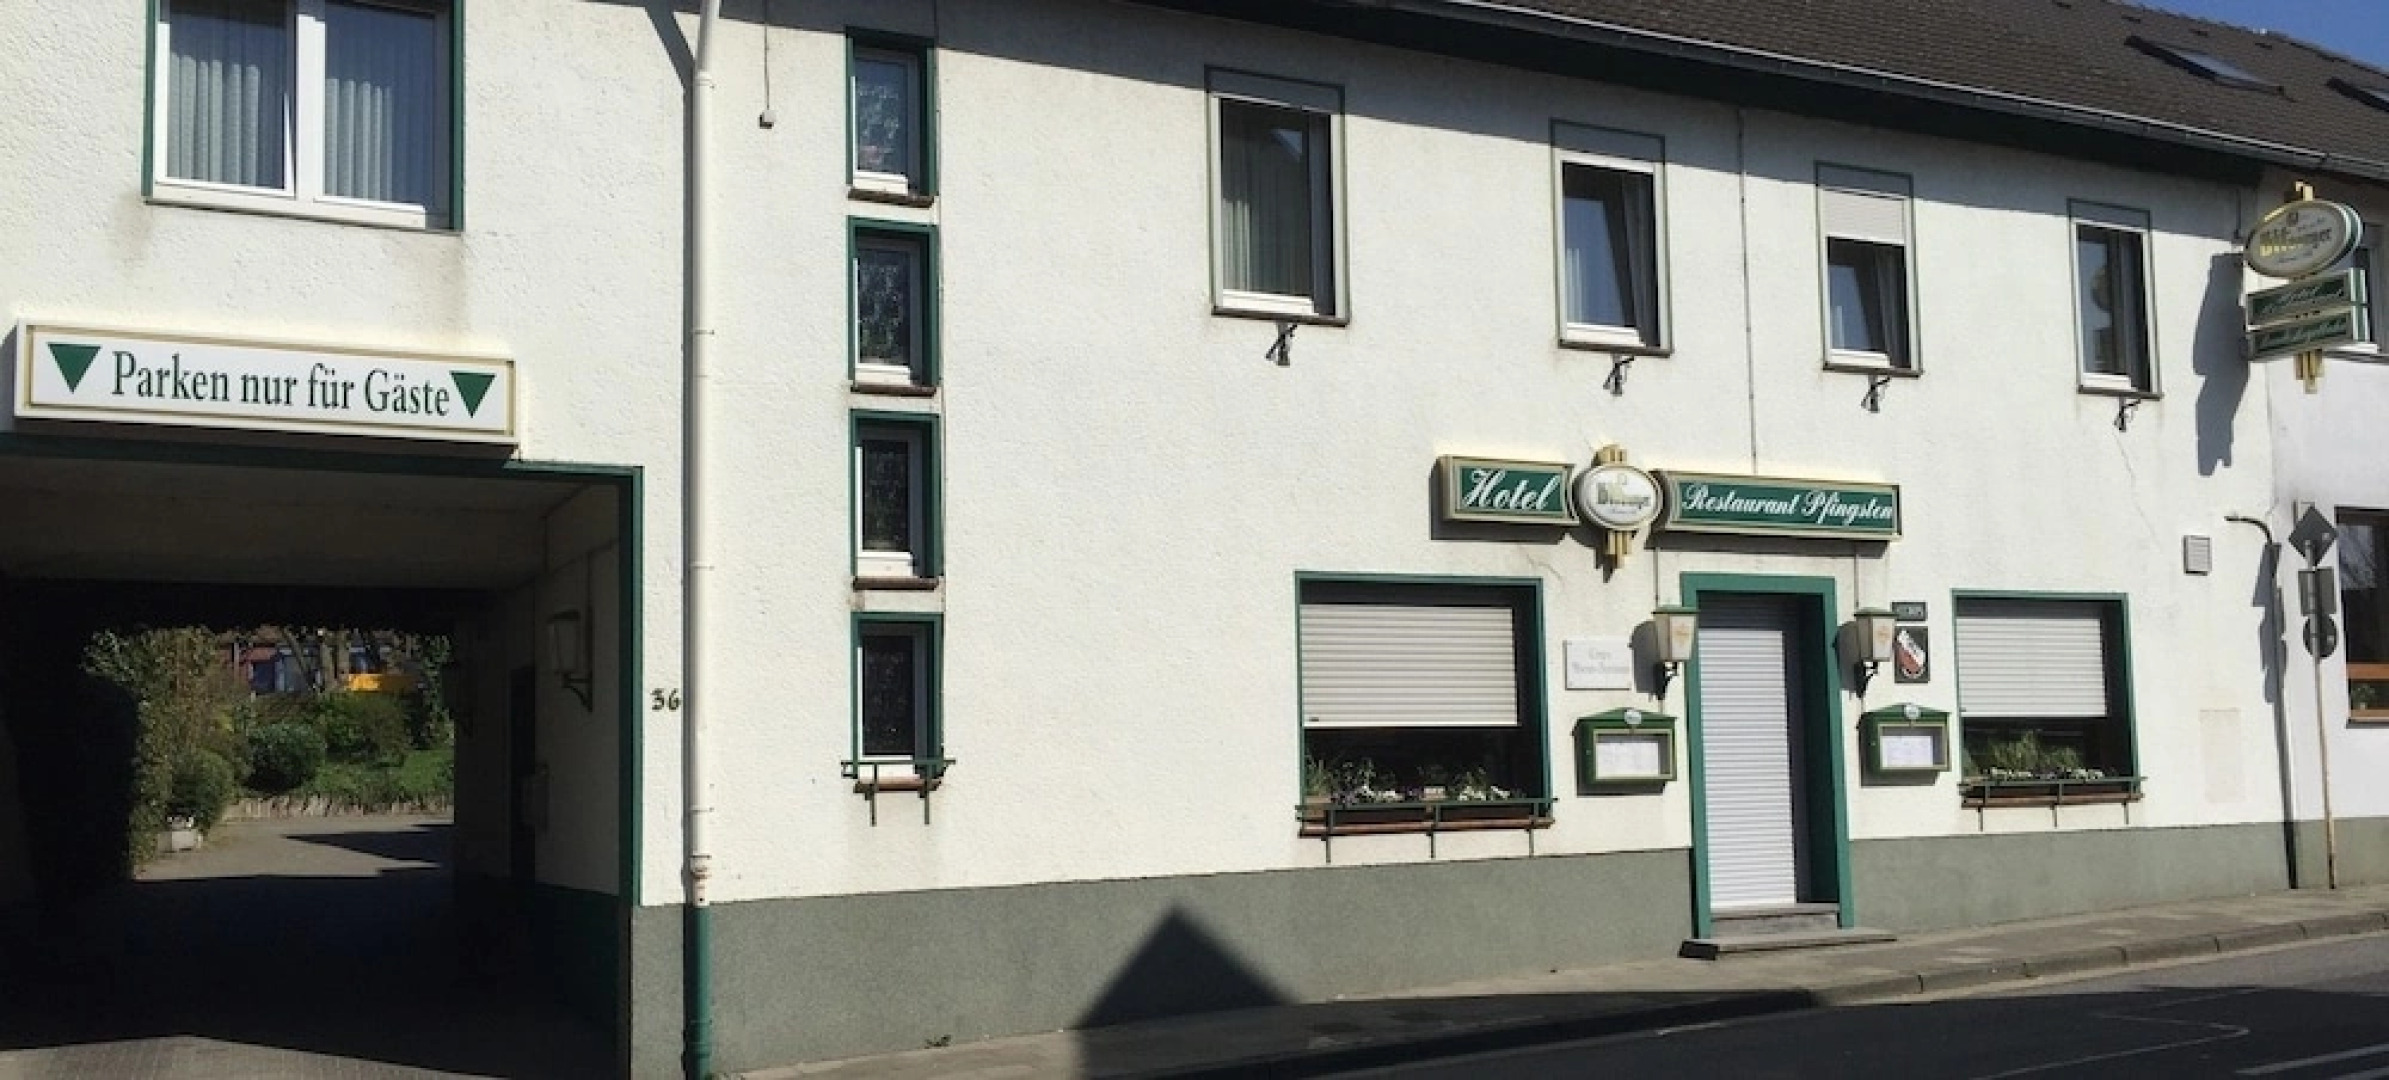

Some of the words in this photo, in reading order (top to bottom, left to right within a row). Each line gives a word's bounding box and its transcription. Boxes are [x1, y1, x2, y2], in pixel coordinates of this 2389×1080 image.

[111, 350, 229, 402] Parken
[240, 371, 296, 406] nur
[307, 363, 355, 410] für
[364, 369, 450, 417] Gäste
[1463, 468, 1560, 510] Hotel
[1682, 484, 1799, 514] Restaurant
[1802, 491, 1893, 526] Pfingsten
[651, 688, 682, 711] 36
